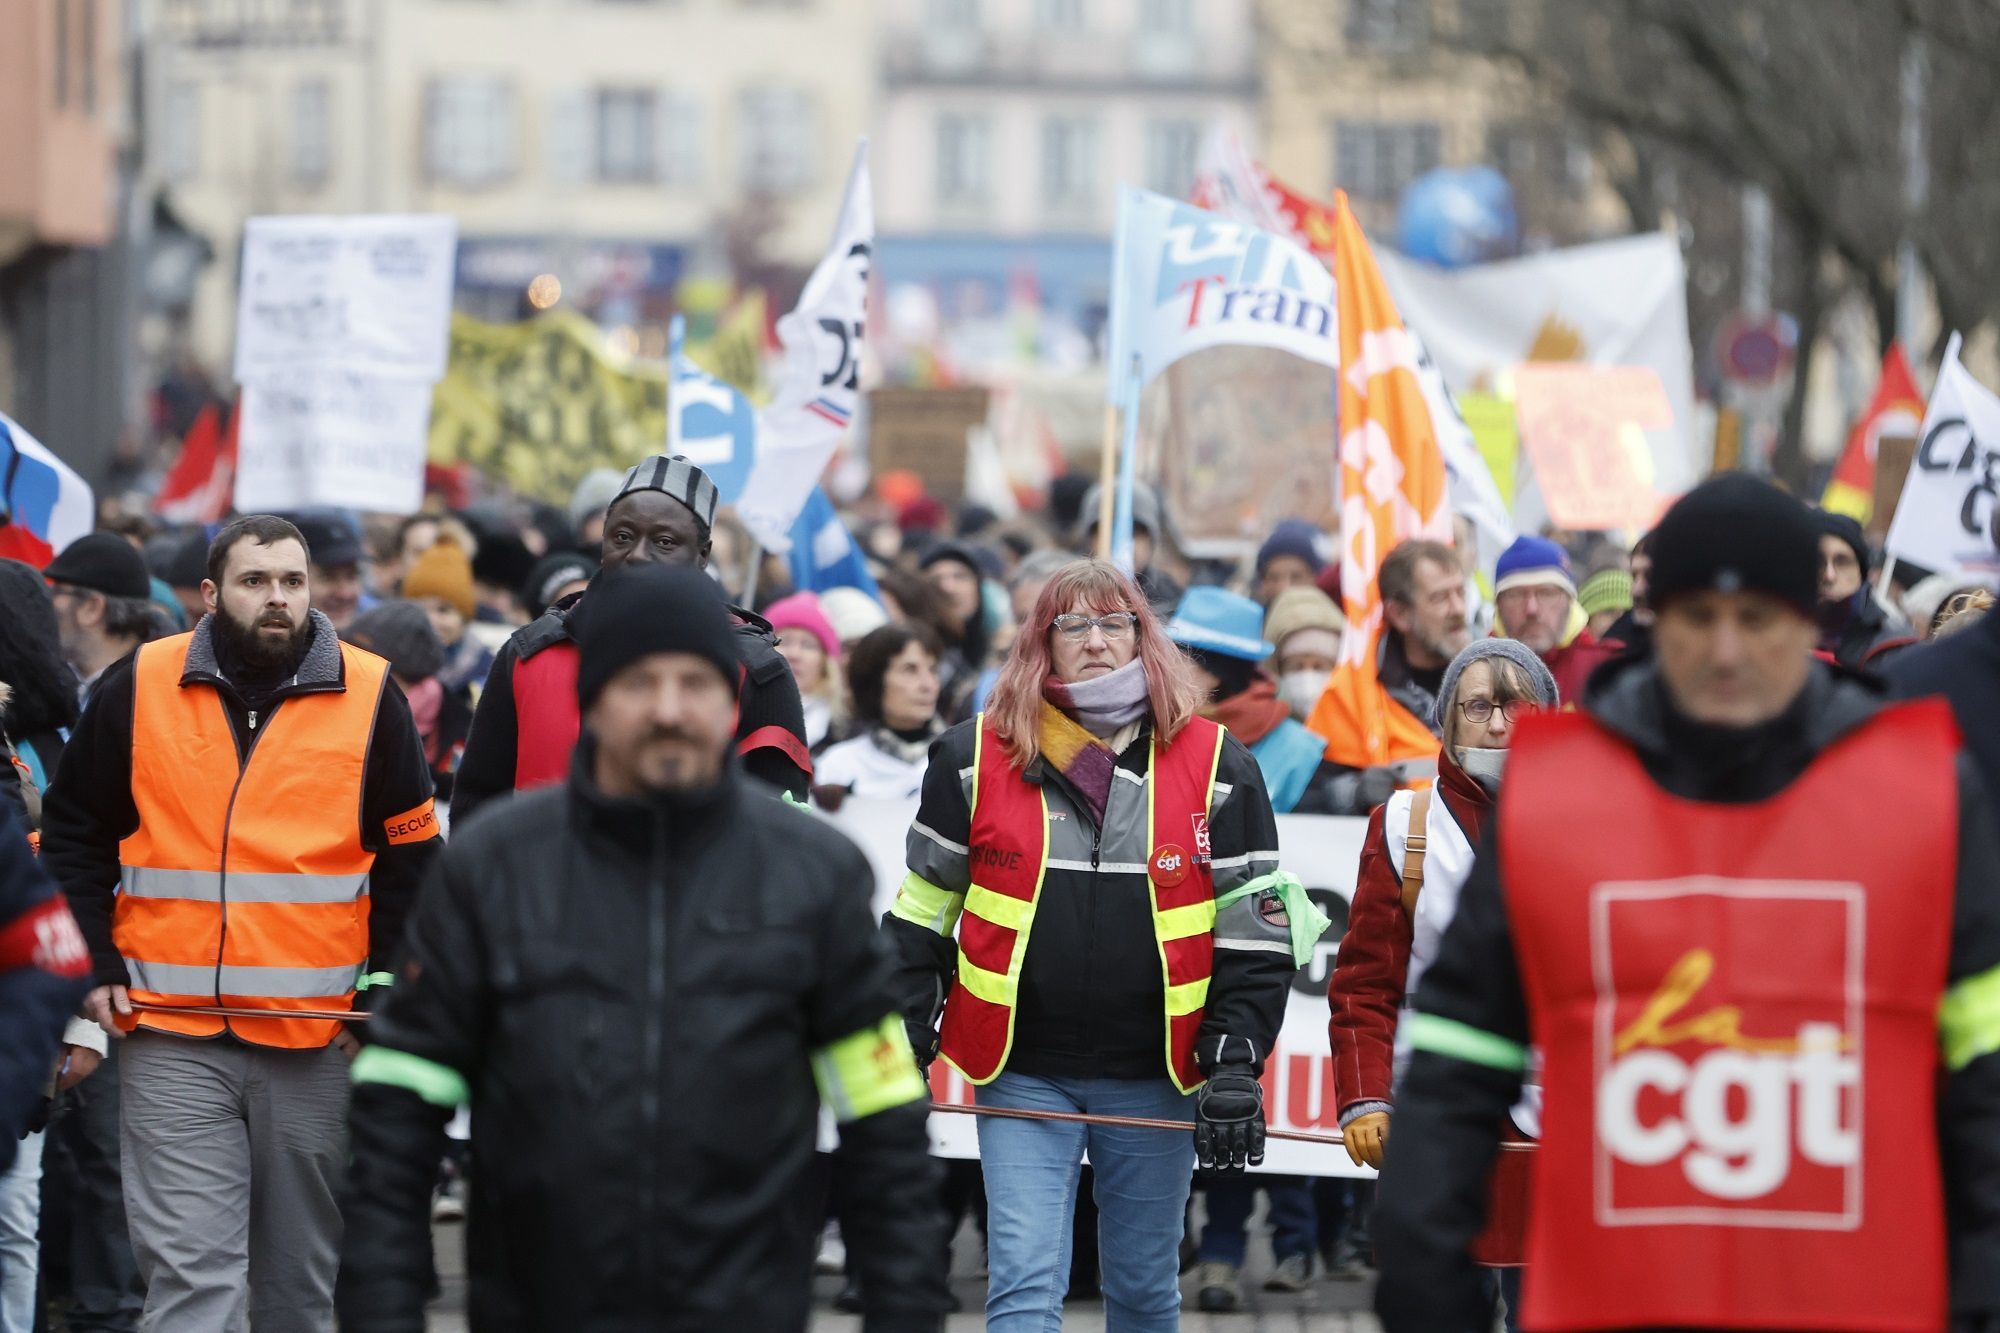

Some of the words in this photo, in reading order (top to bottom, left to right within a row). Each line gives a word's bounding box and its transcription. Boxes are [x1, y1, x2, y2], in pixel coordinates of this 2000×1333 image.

[1157, 855, 1181, 870] cgt
[1611, 947, 1800, 1057] la
[1598, 1021, 1858, 1200] cgt
